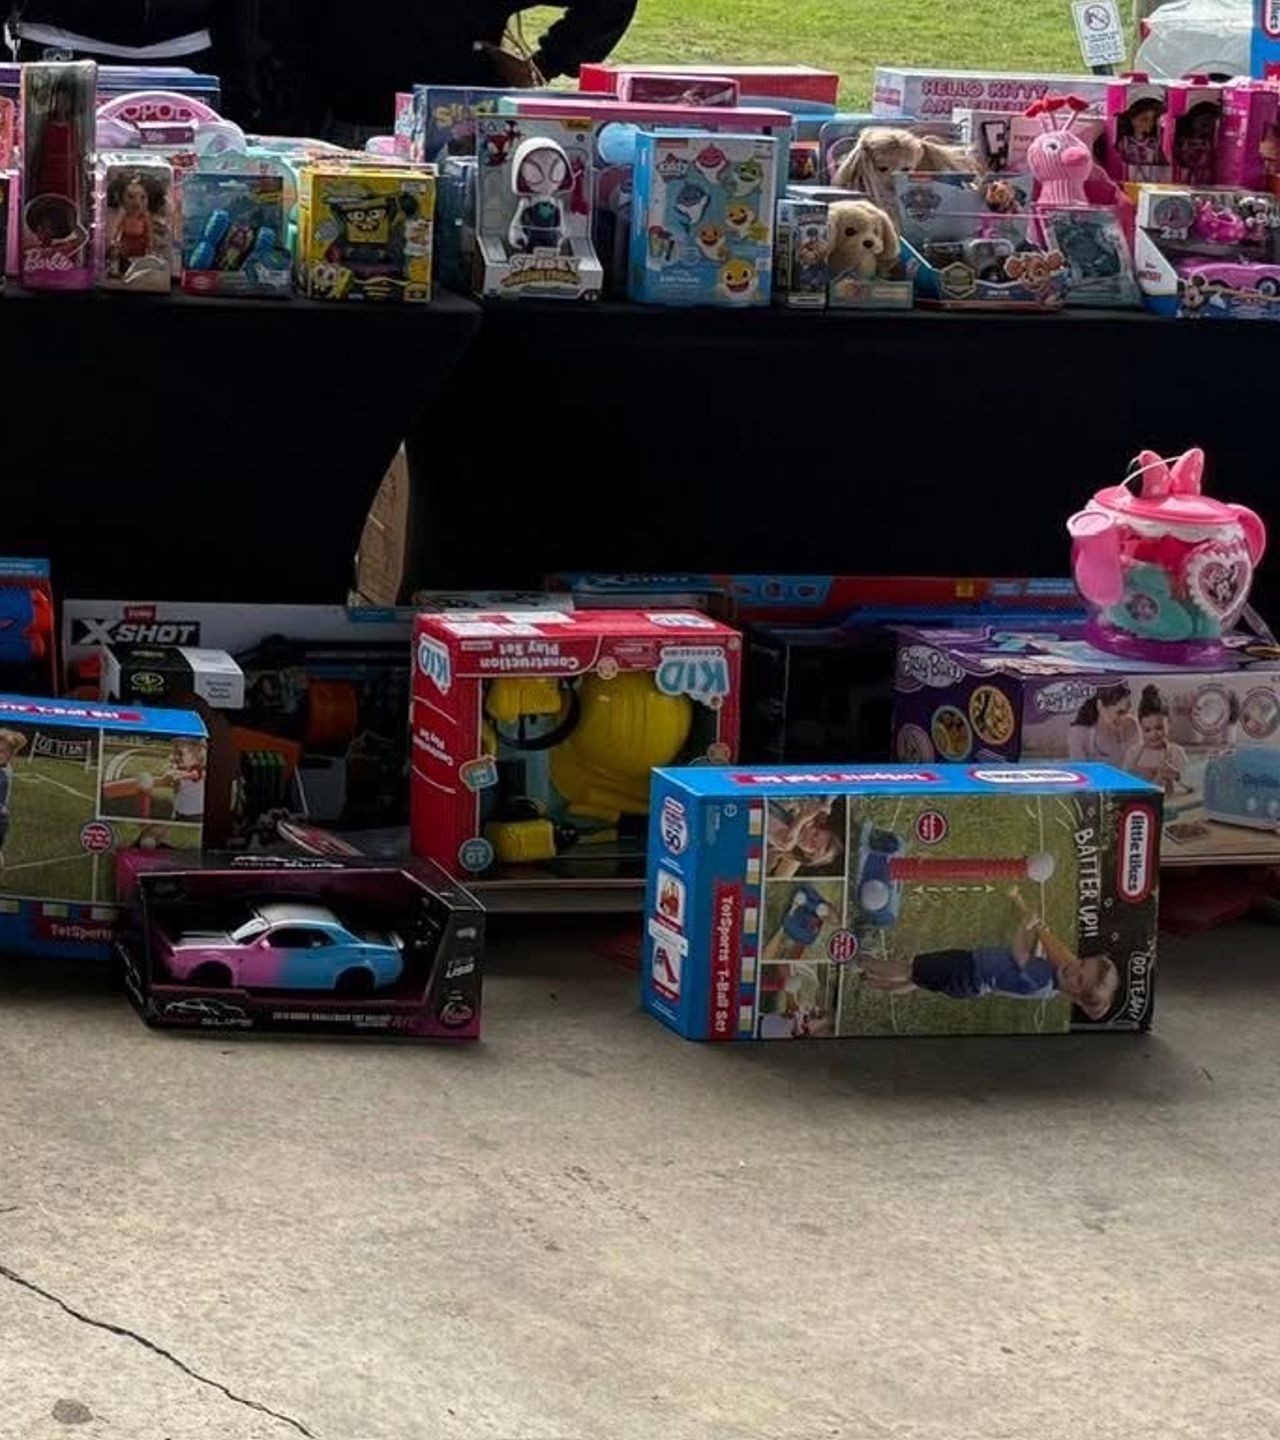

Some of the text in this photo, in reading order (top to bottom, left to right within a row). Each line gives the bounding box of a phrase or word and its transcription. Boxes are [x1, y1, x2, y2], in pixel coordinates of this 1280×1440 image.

[922, 79, 1049, 98] HELLO KITTY
[479, 656, 580, 671] Construction
[657, 659, 725, 694] KID
[1073, 826, 1100, 901] BATTER
[1128, 807, 1149, 893] little tikes
